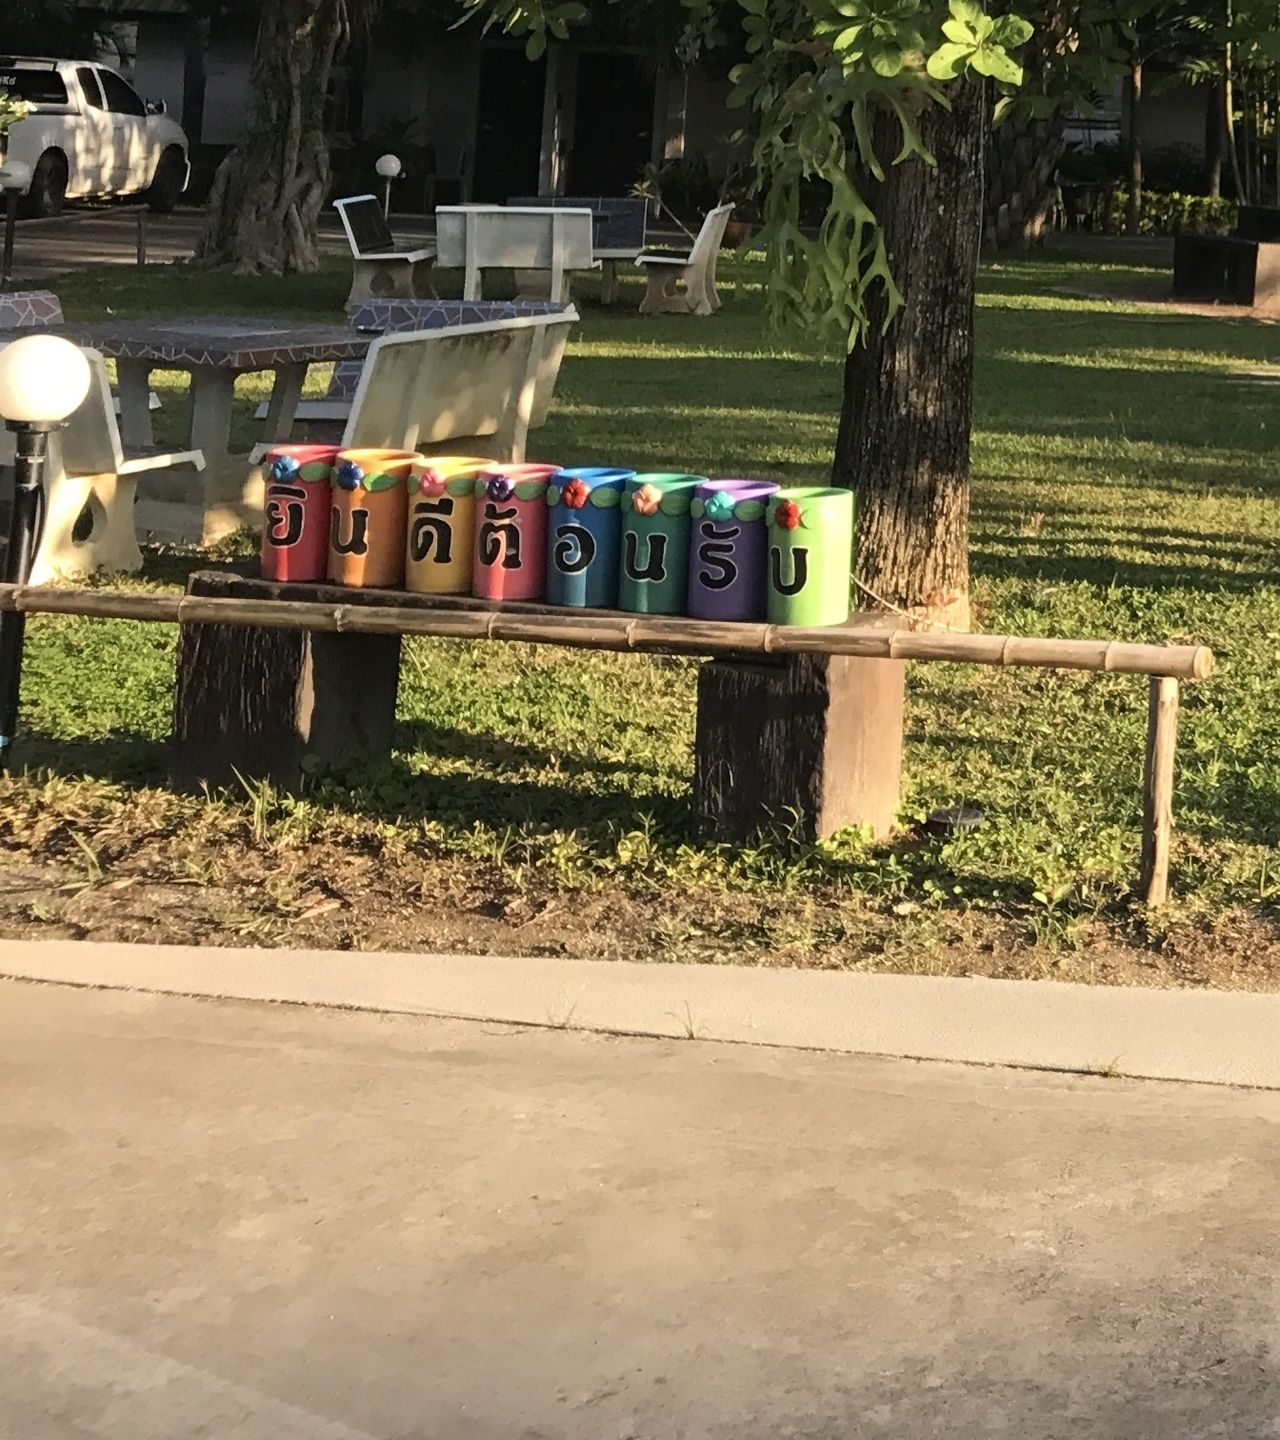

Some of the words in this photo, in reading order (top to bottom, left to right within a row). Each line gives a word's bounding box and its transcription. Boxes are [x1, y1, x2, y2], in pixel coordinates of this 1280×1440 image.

[265, 485, 809, 596] ยินดีต้อนรับ
